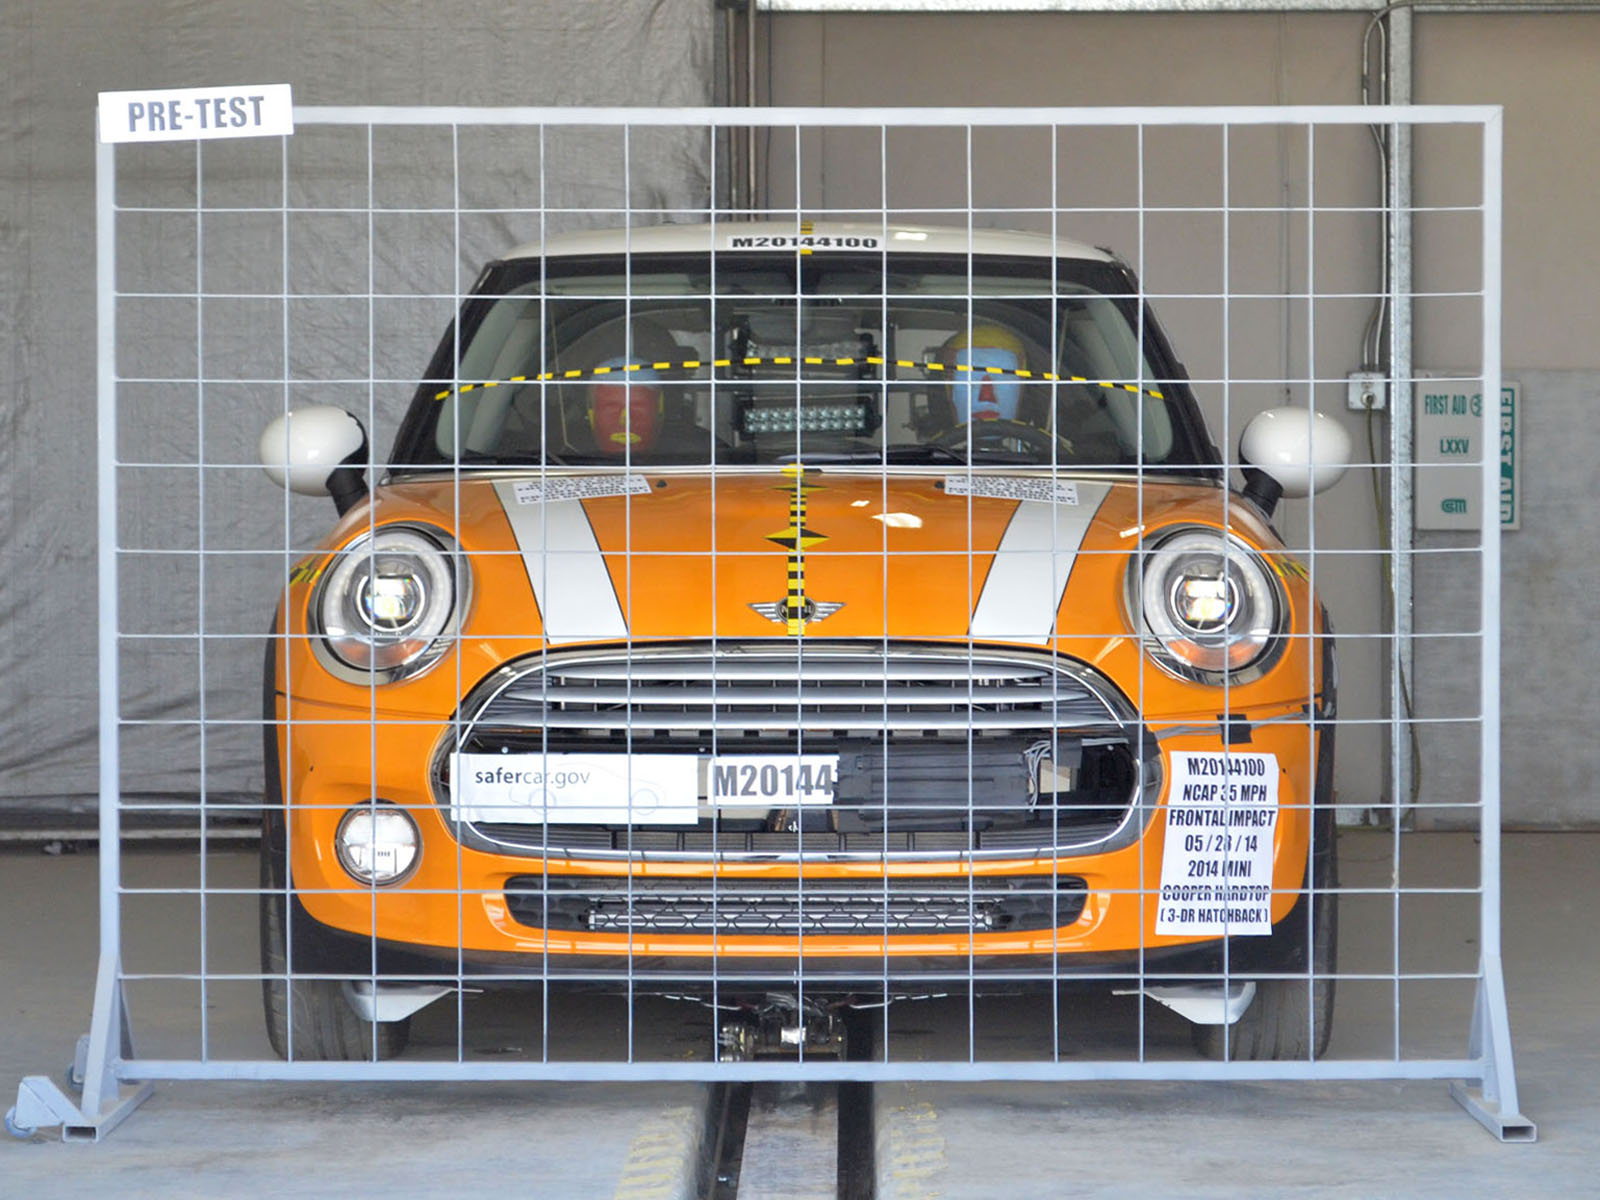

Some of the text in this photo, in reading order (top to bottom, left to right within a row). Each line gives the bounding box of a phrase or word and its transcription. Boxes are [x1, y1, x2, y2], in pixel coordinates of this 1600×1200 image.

[128, 96, 265, 132] PRE-TEST
[732, 237, 878, 248] M20144100
[1424, 394, 1467, 415] FIRST AID
[1440, 439, 1469, 454] LXXV
[1187, 758, 1265, 776] M20144100
[475, 767, 591, 789] safercar.gov
[1183, 784, 1267, 801] NCAP 35 MPH
[1169, 809, 1275, 827] FRONTAL IMPACT
[1185, 835, 1203, 852] 05
[1245, 835, 1258, 852] 14
[1188, 860, 1252, 877] 2014 MINI
[1162, 885, 1270, 901] COOPER HARDTOP
[1168, 908, 1195, 923] 3-DR
[1199, 908, 1262, 923] HATCHBACK
